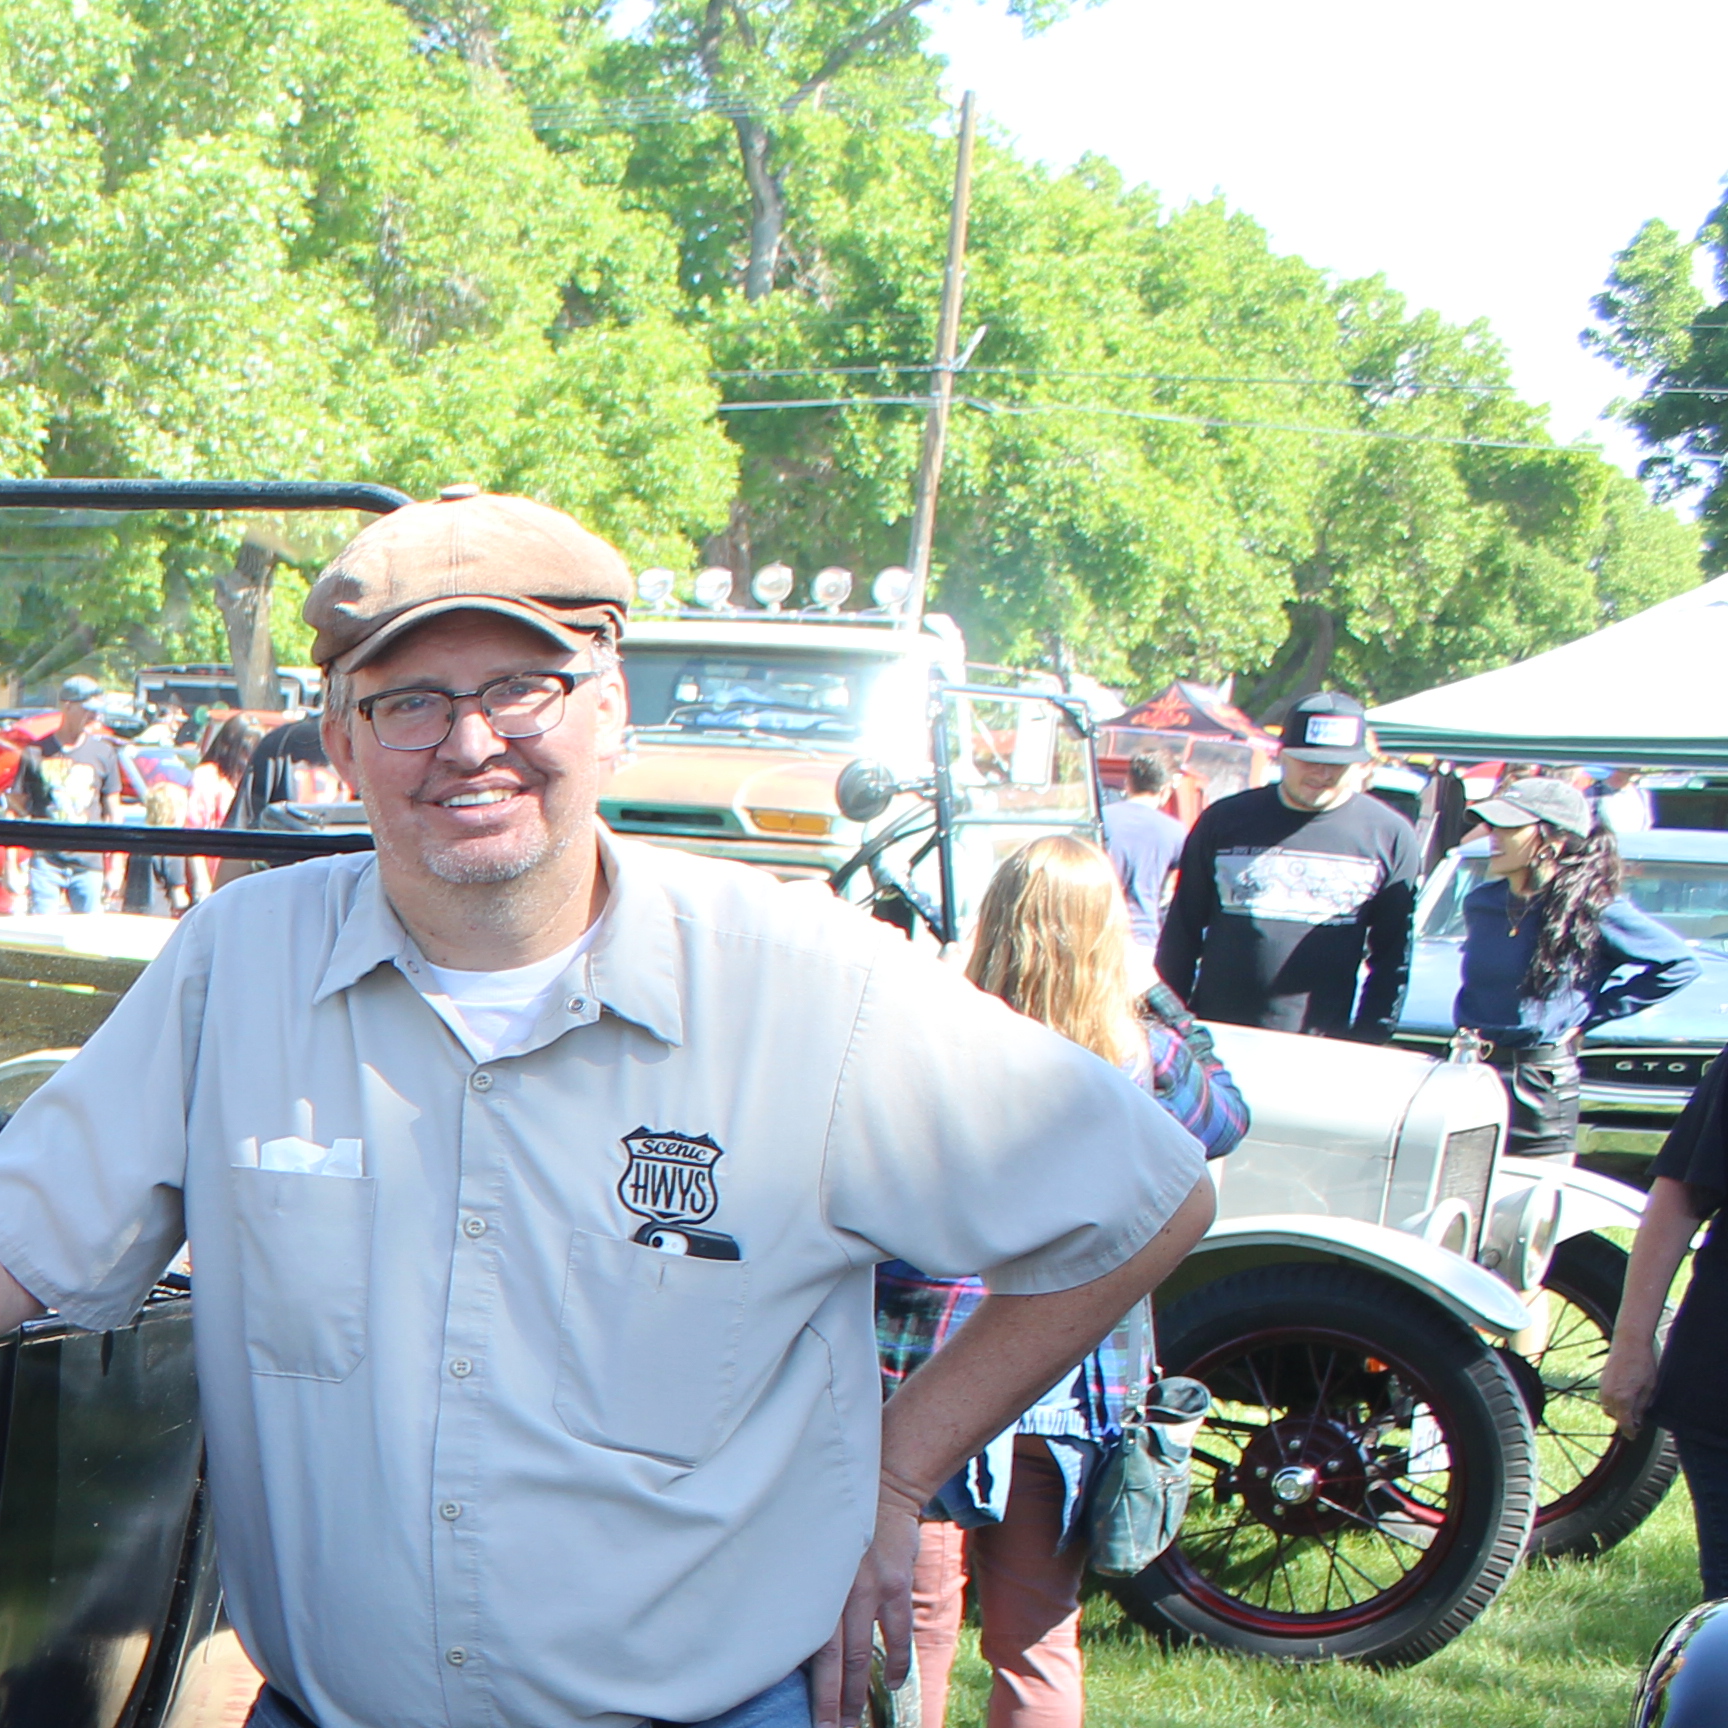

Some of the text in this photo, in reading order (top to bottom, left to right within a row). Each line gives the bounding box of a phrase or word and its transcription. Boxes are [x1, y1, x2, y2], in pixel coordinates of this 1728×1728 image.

[1615, 1061, 1687, 1073] GTO
[637, 1139, 707, 1161] Scenic
[629, 1162, 707, 1215] HWYS
